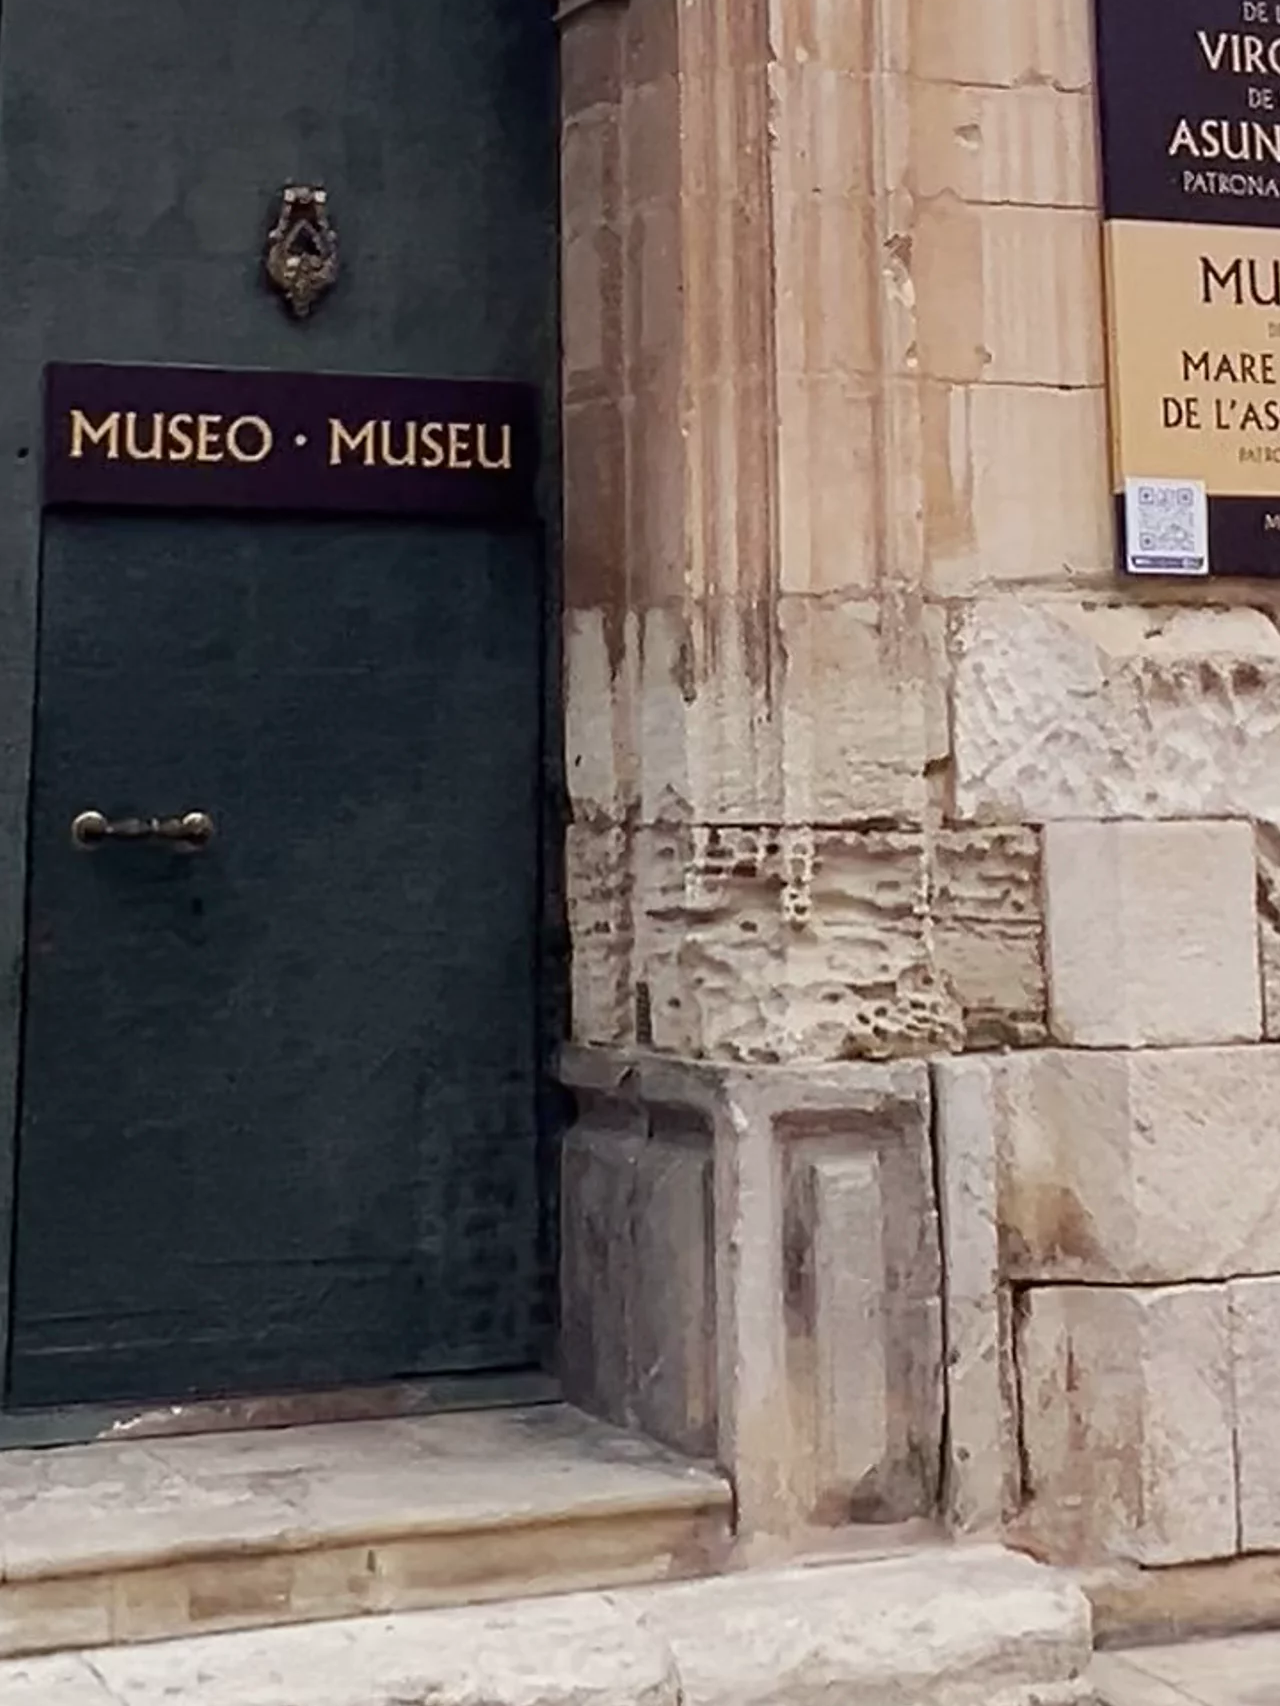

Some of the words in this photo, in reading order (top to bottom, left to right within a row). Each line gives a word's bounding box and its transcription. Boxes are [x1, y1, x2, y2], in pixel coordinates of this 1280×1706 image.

[1242, 0, 1269, 24] DE
[1248, 87, 1274, 110] DE
[1183, 170, 1280, 199] PATRONA
[1181, 349, 1277, 385] MARE
[1162, 396, 1201, 430] DE
[69, 408, 274, 463] MUSEO
[328, 417, 512, 470] MUSEU
